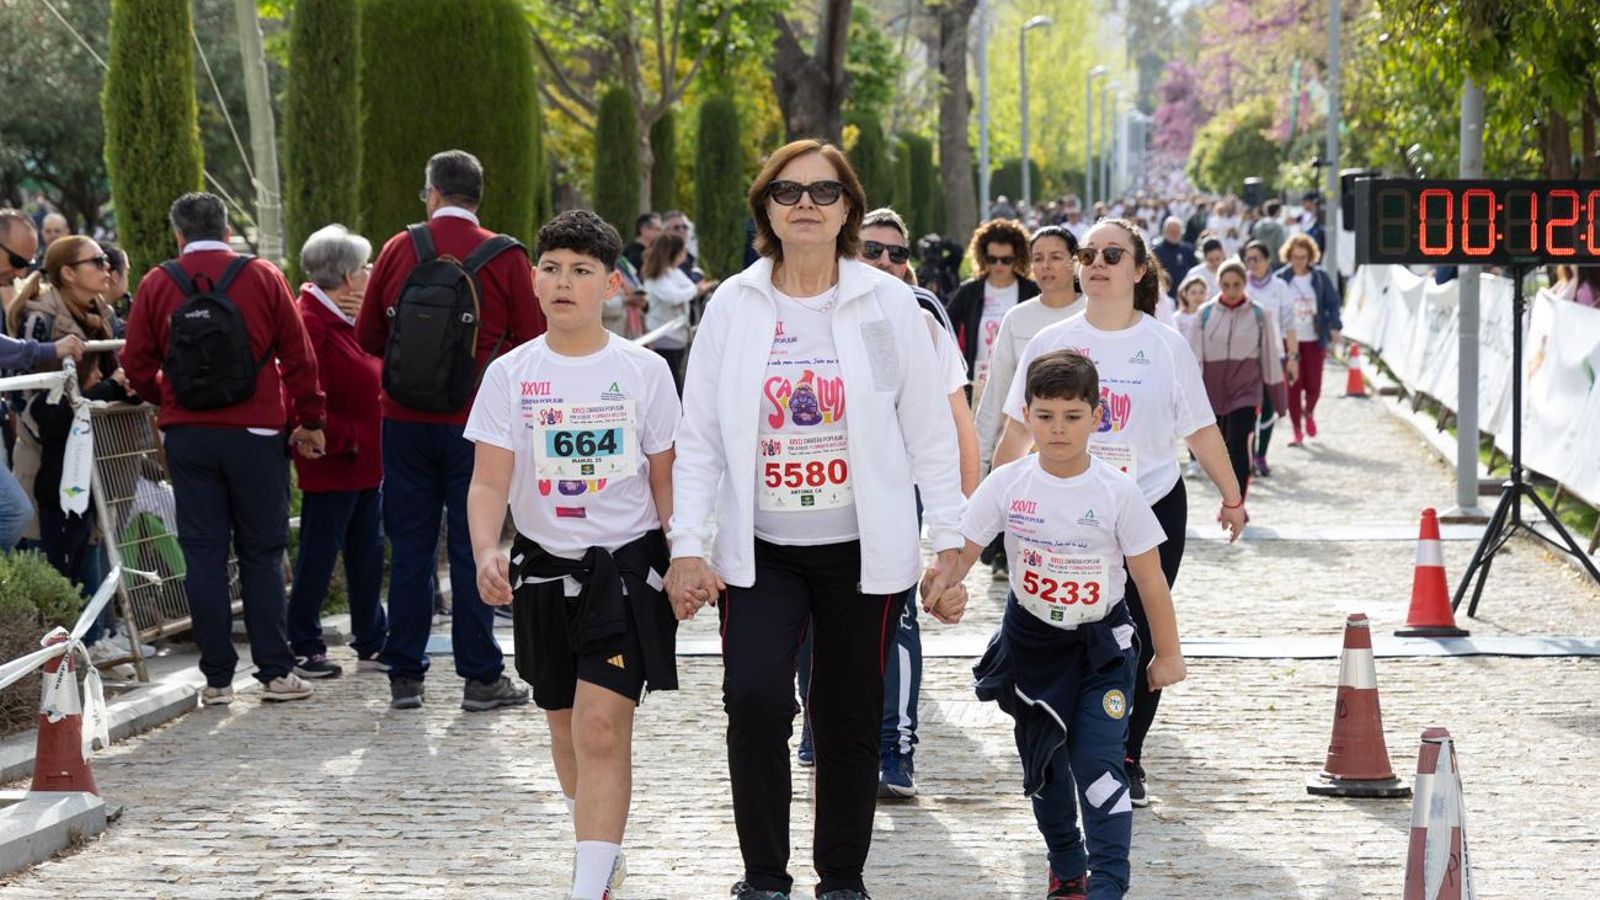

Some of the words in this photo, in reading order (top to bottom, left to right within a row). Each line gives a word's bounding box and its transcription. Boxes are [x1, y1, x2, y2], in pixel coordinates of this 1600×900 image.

[520, 381, 551, 396] XXVII
[764, 376, 846, 429] SALUD
[554, 429, 617, 457] 664
[765, 459, 848, 488] 5580
[1010, 499, 1037, 514] XXVII
[1023, 570, 1100, 605] 5233
